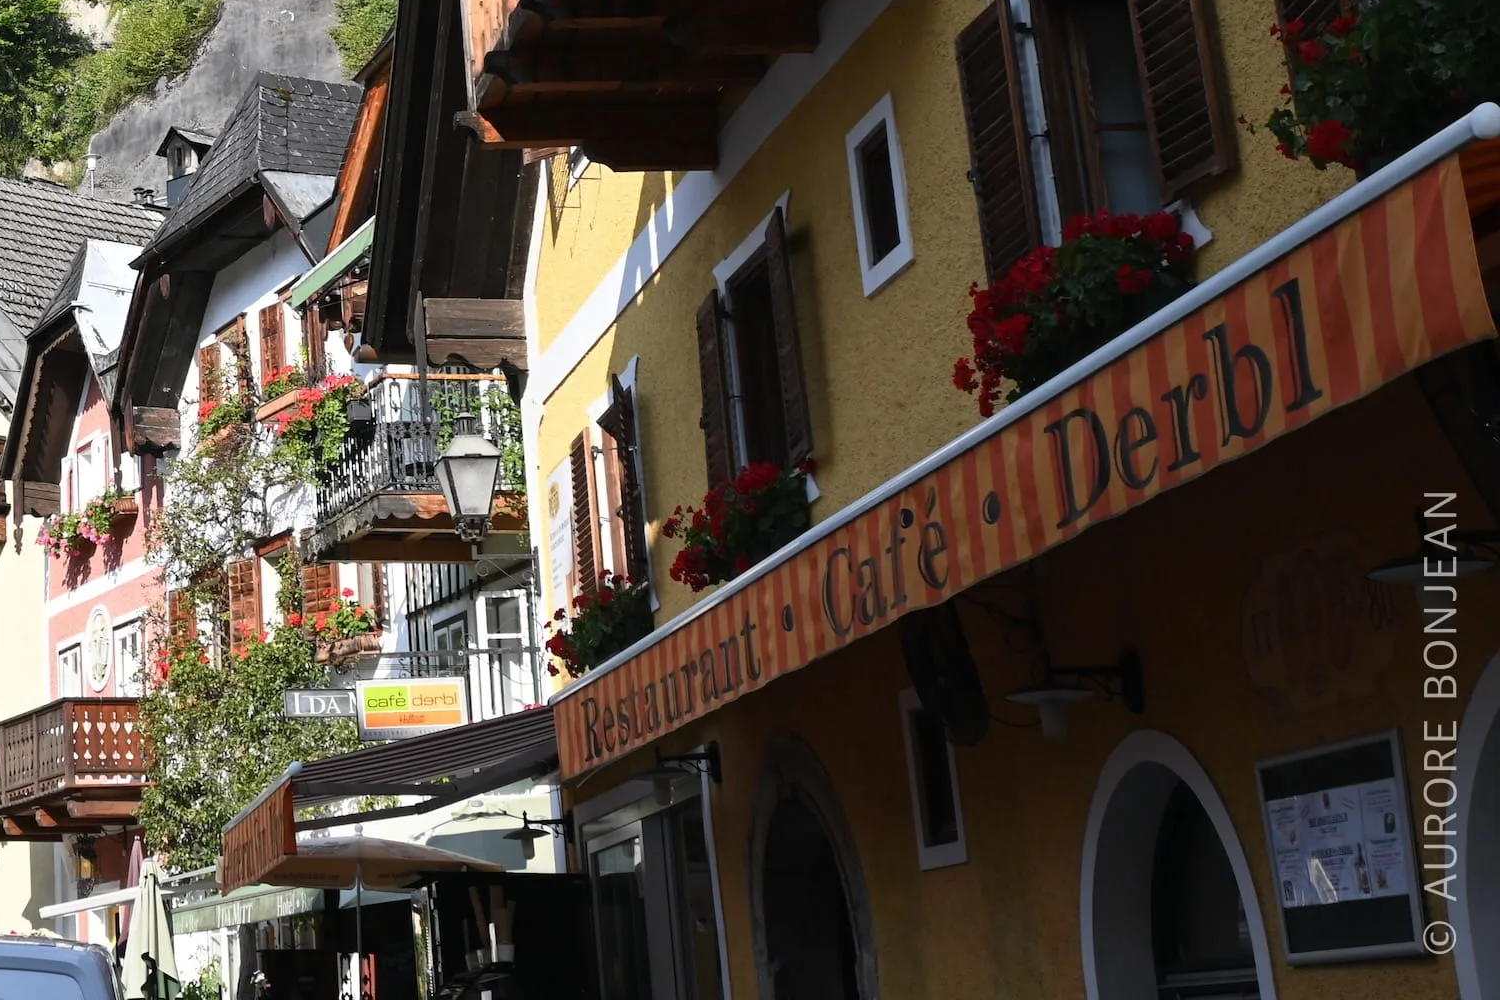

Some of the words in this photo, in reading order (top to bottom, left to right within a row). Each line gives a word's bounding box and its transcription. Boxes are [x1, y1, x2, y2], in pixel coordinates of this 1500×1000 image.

[580, 609, 762, 763] Restaurant
[821, 487, 951, 638] Café
[1044, 277, 1324, 530] Derbl
[293, 690, 342, 715] IDA
[366, 691, 407, 708] café
[277, 888, 295, 918] Hotel
